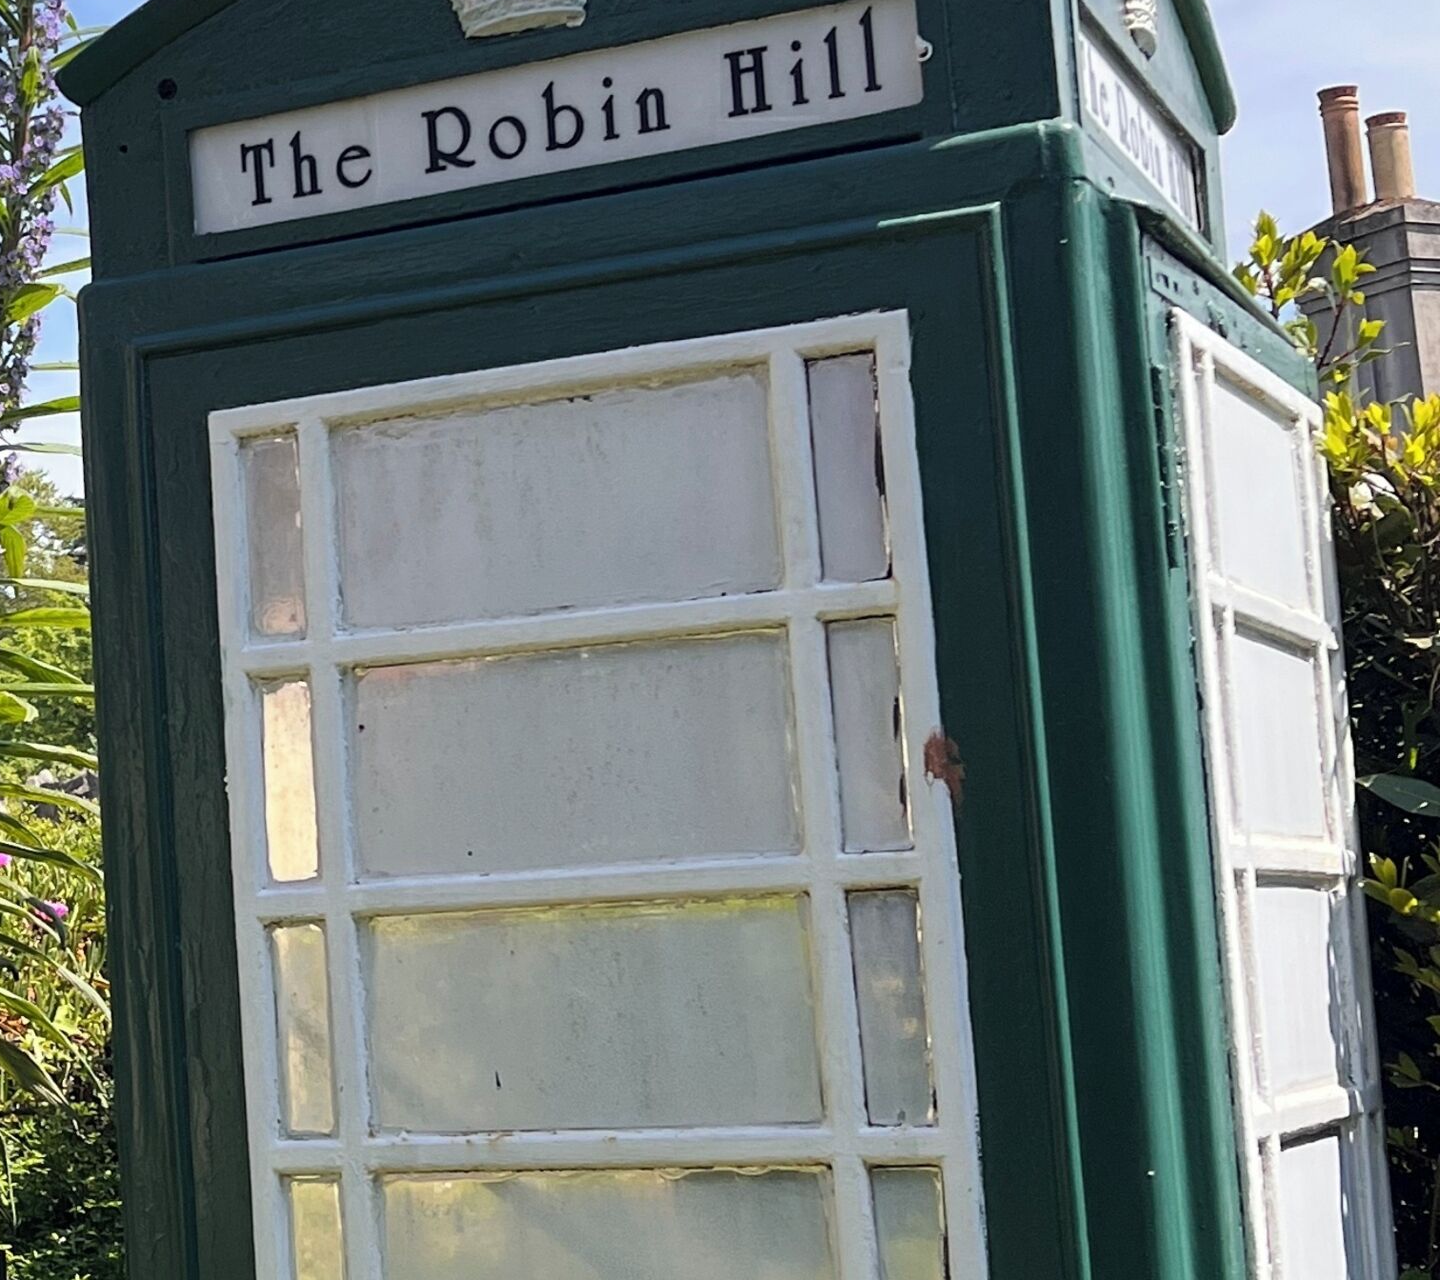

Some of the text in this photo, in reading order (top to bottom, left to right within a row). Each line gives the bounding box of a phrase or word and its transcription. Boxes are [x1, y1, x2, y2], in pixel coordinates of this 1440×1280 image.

[239, 5, 883, 207] The Robin Hill
[1086, 40, 1110, 127] he
